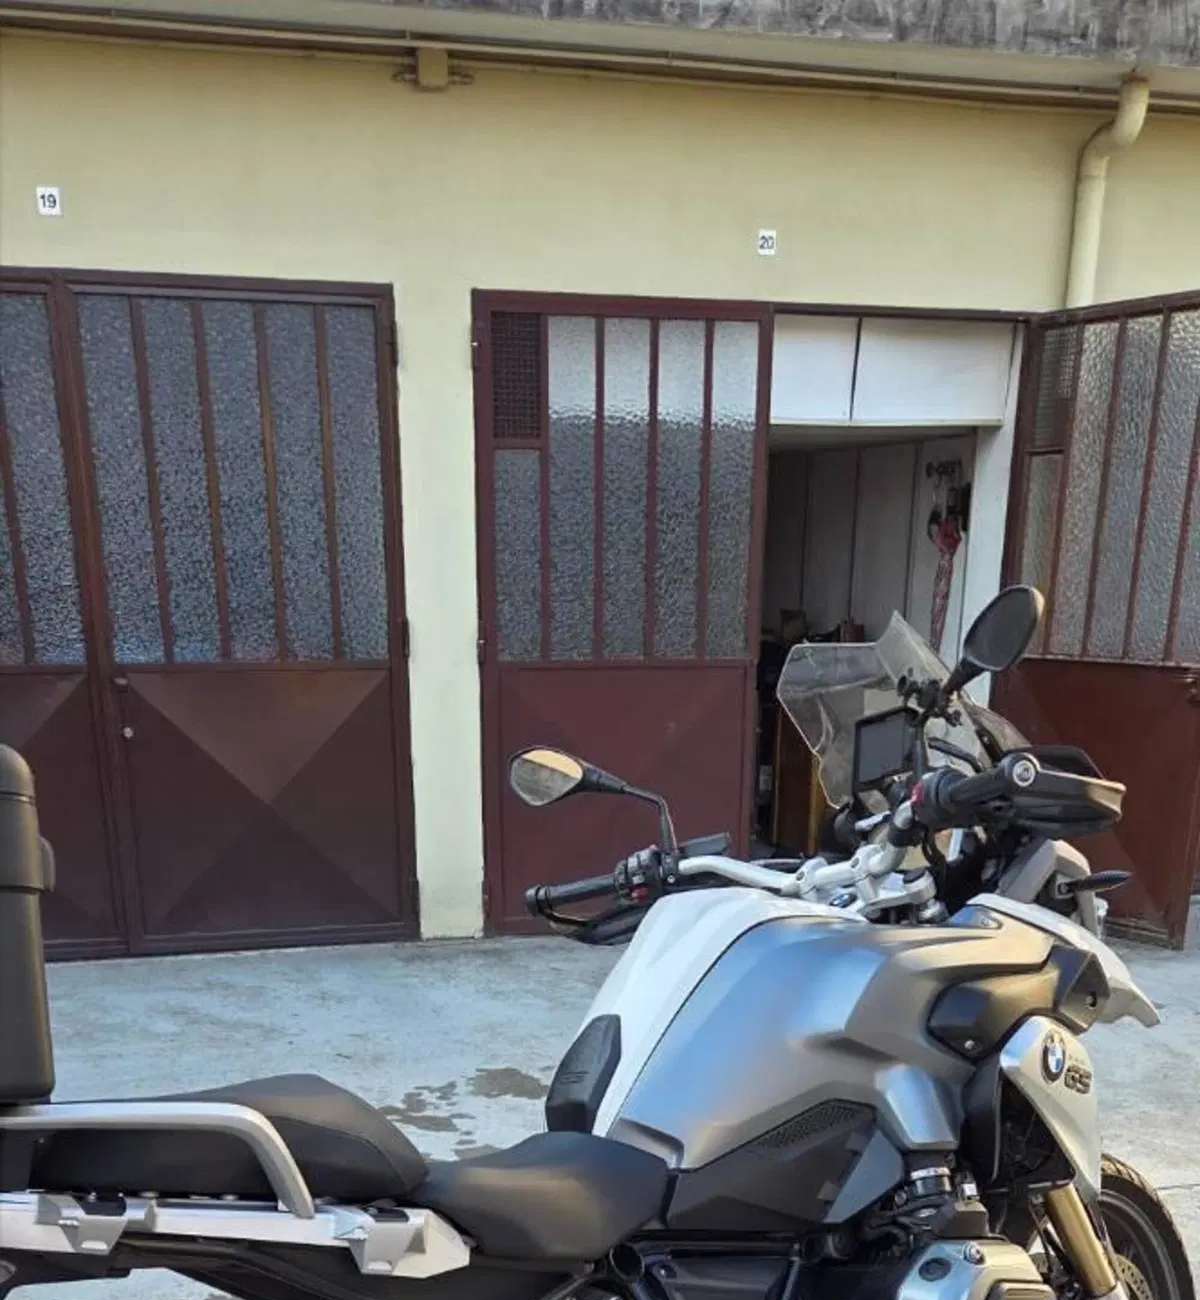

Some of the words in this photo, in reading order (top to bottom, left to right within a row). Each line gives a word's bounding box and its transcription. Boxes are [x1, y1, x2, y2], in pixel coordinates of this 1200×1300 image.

[40, 194, 56, 208] 19
[760, 235, 774, 249] 20
[1064, 1065, 1092, 1094] GS
